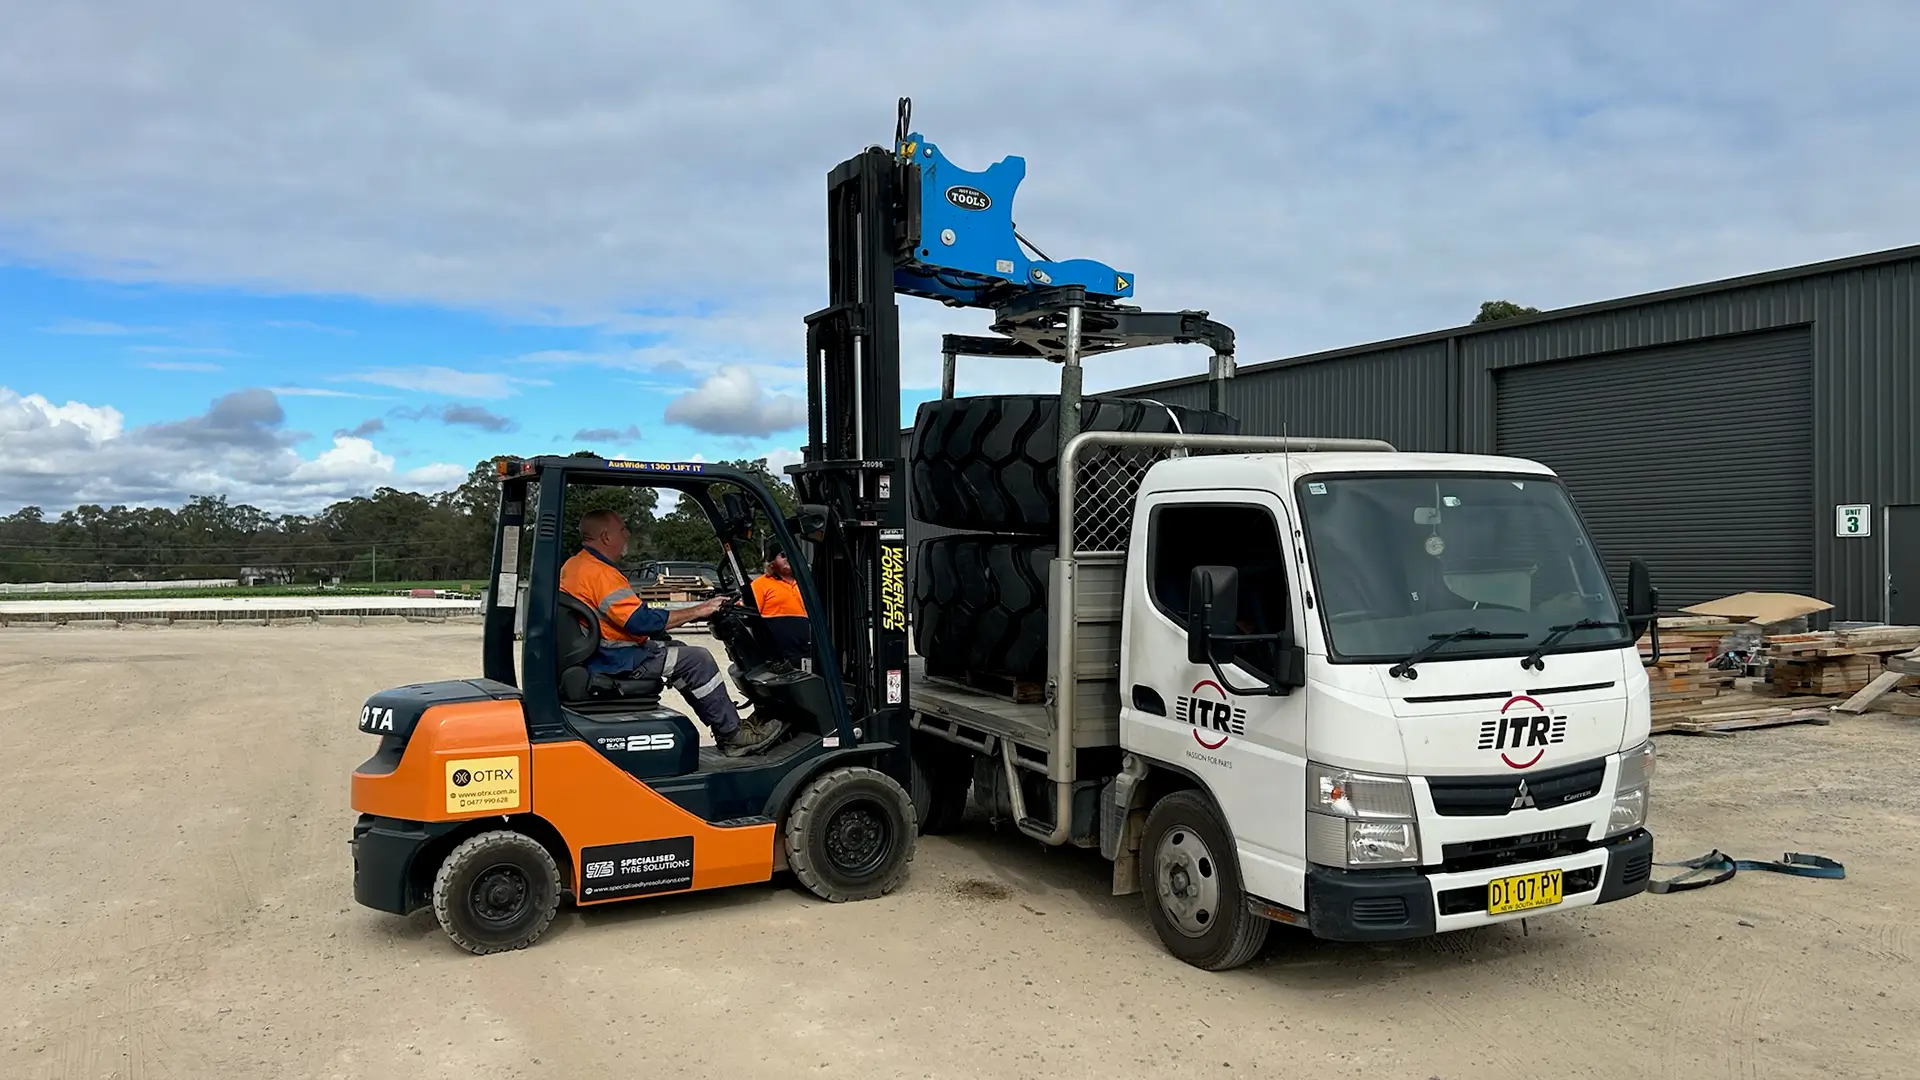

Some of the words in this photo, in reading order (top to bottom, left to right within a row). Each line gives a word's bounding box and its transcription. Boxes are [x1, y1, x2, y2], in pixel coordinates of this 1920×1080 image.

[951, 192, 986, 207] TOOLS
[608, 460, 647, 469] AusWide:
[650, 463, 671, 471] 1300
[693, 464, 702, 472] IT
[1847, 516, 1859, 533] 3
[881, 545, 894, 630] FORKLIFTS
[892, 547, 905, 633] WAVERLEY
[1189, 697, 1232, 734] ITR
[1495, 716, 1551, 750] ITR
[627, 733, 675, 751] 25
[1186, 750, 1207, 762] PASSION
[1207, 755, 1218, 765] FOR
[1218, 759, 1232, 769] PARTS
[473, 768, 514, 782] OTRX
[458, 788, 517, 798] www.otrx.com.au
[620, 854, 675, 867] SPECIALISED
[621, 866, 641, 874] TYRE
[643, 859, 690, 872] SOLUTIONS
[593, 877, 690, 893] www.specialisedtyresolutions.com
[1515, 901, 1534, 909] SOUTH
